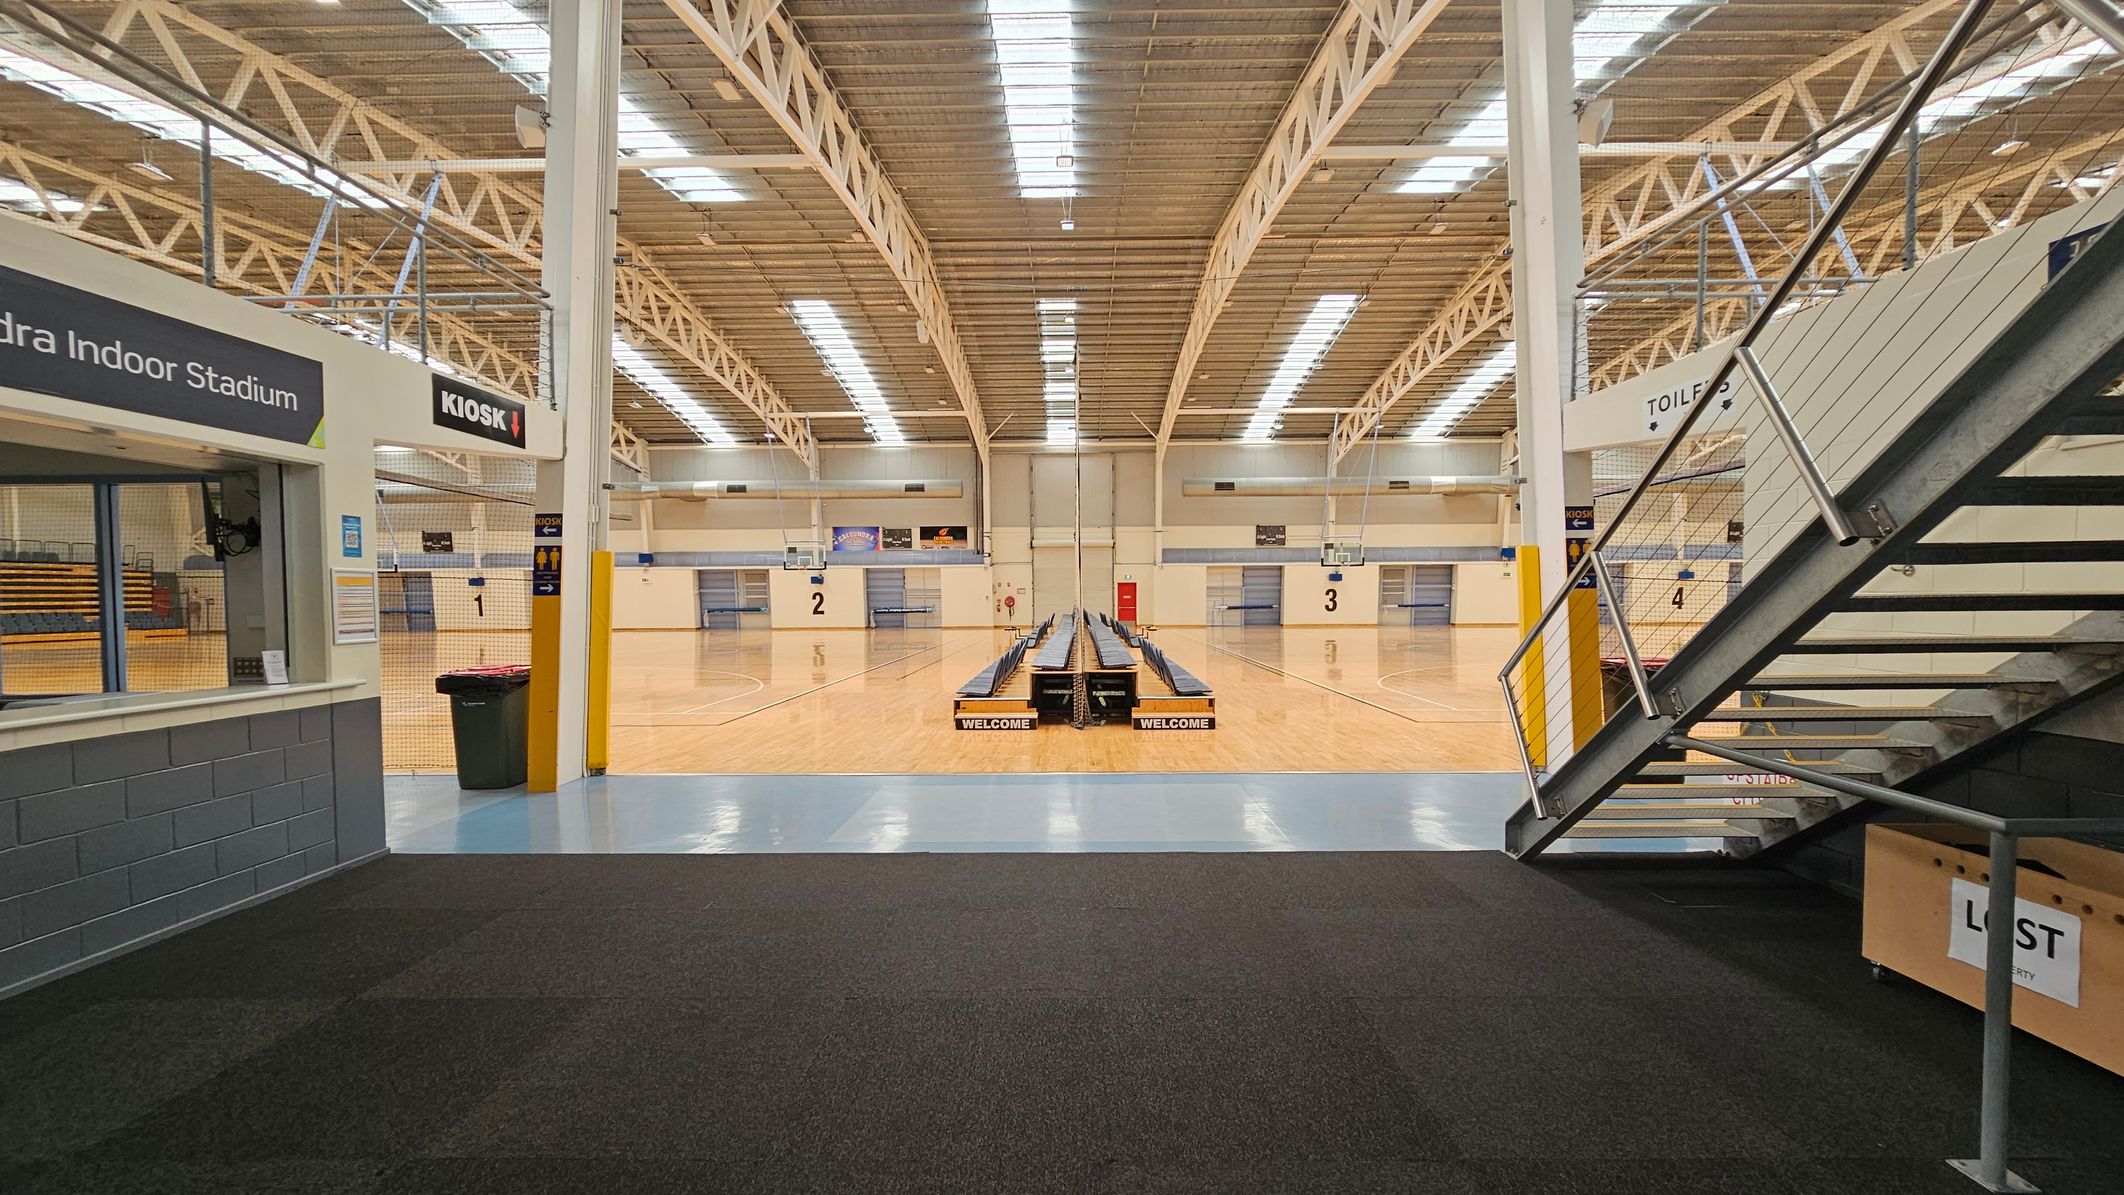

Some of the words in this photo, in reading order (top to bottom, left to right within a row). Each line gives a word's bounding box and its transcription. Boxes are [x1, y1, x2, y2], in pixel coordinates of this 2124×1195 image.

[68, 330, 178, 381] Indoor
[186, 361, 298, 411] Stadium
[441, 390, 507, 431] KIOSK
[536, 517, 562, 526] KIOSK
[1566, 510, 1593, 519] KIOSK
[474, 594, 484, 617] 1
[812, 592, 825, 615] 2
[1325, 588, 1337, 612] 3
[1672, 586, 1684, 610] 4
[962, 718, 1030, 729] WELCOME
[1140, 718, 1209, 729] WELCOME
[1966, 899, 2064, 959] LST
